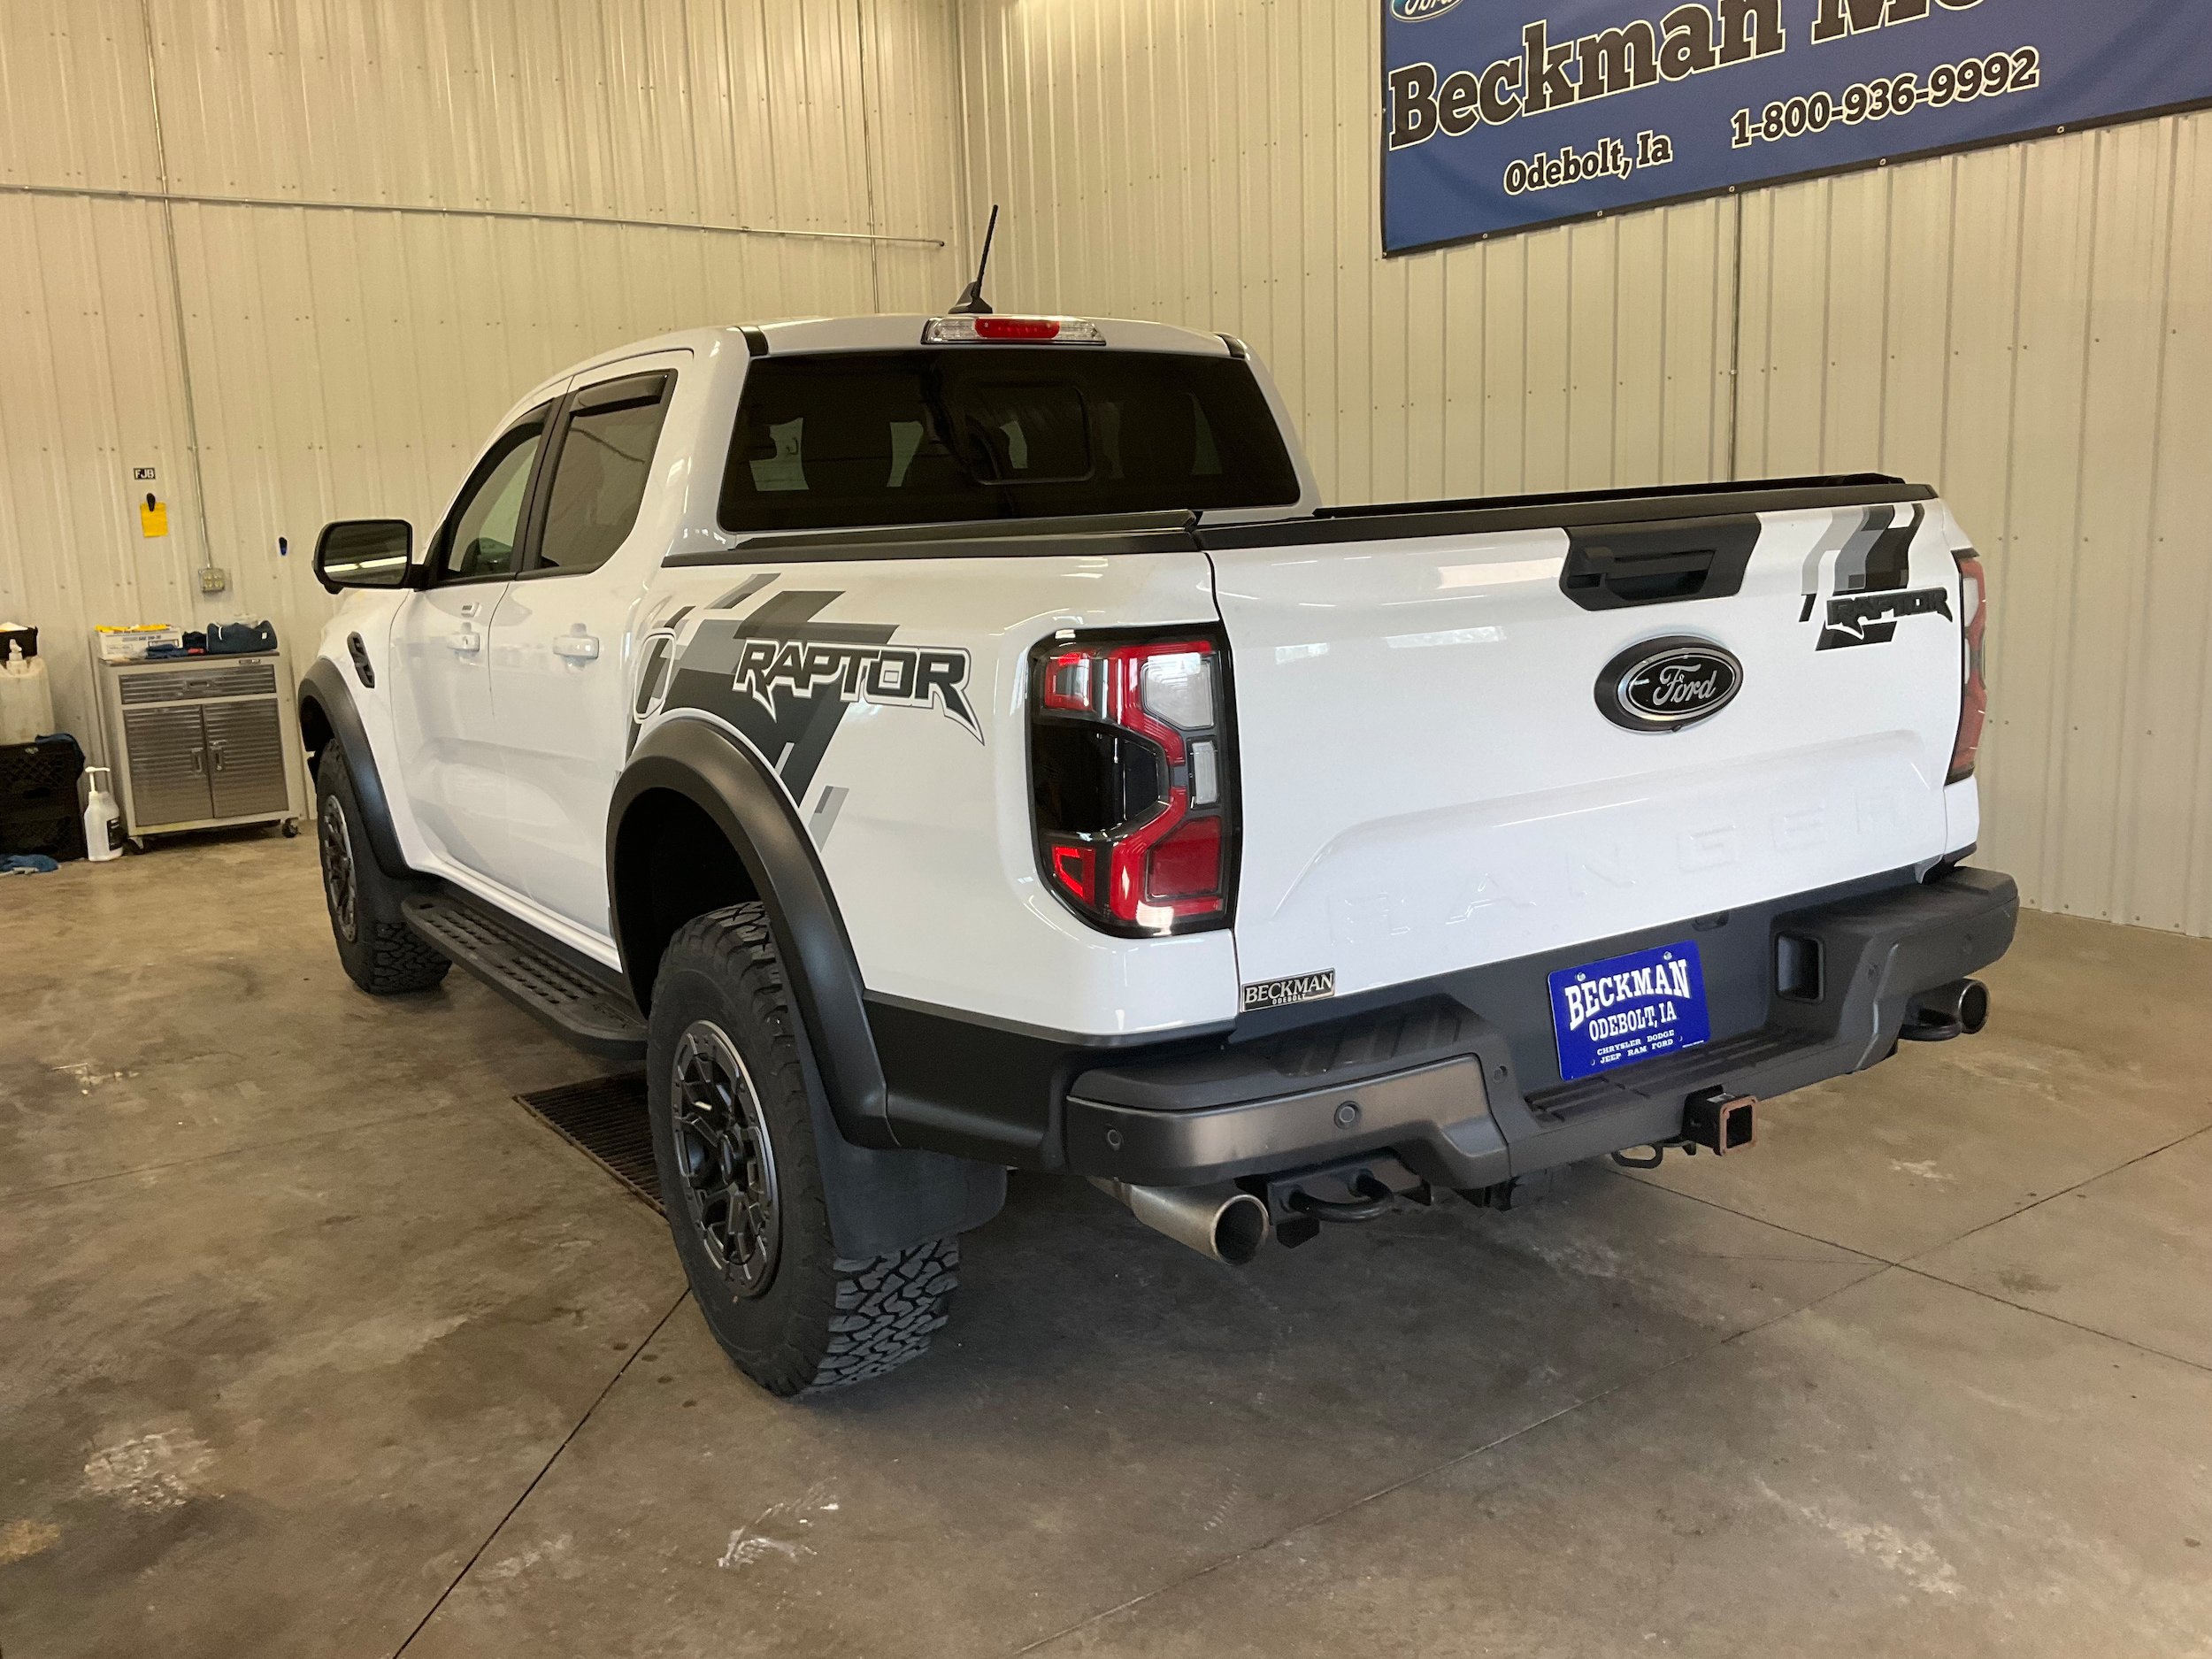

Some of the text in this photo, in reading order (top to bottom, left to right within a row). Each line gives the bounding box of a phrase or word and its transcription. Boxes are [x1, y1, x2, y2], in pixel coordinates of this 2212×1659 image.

[1388, 0, 1786, 150] Beckman
[1732, 47, 2040, 149] 1-800-936-9992
[1503, 130, 1673, 195] Odebolt, Ia
[134, 469, 155, 479] FJB
[1827, 587, 1953, 635] RAPTOR
[733, 639, 984, 745] RAPTOR
[1653, 664, 1718, 706] Ford
[1328, 789, 1902, 946] RANGER
[1245, 972, 1333, 1003] BECKMAN
[1271, 993, 1306, 1005] ODEBOLT
[1564, 959, 1692, 1031] BECKMAN
[1588, 1001, 1678, 1041] ODEBOLT, IA
[1596, 1029, 1675, 1056] CHRYSLER DODGE
[1600, 1053, 1622, 1064] JEEP
[1627, 1046, 1647, 1056] RAM
[1652, 1039, 1674, 1050] FORD
